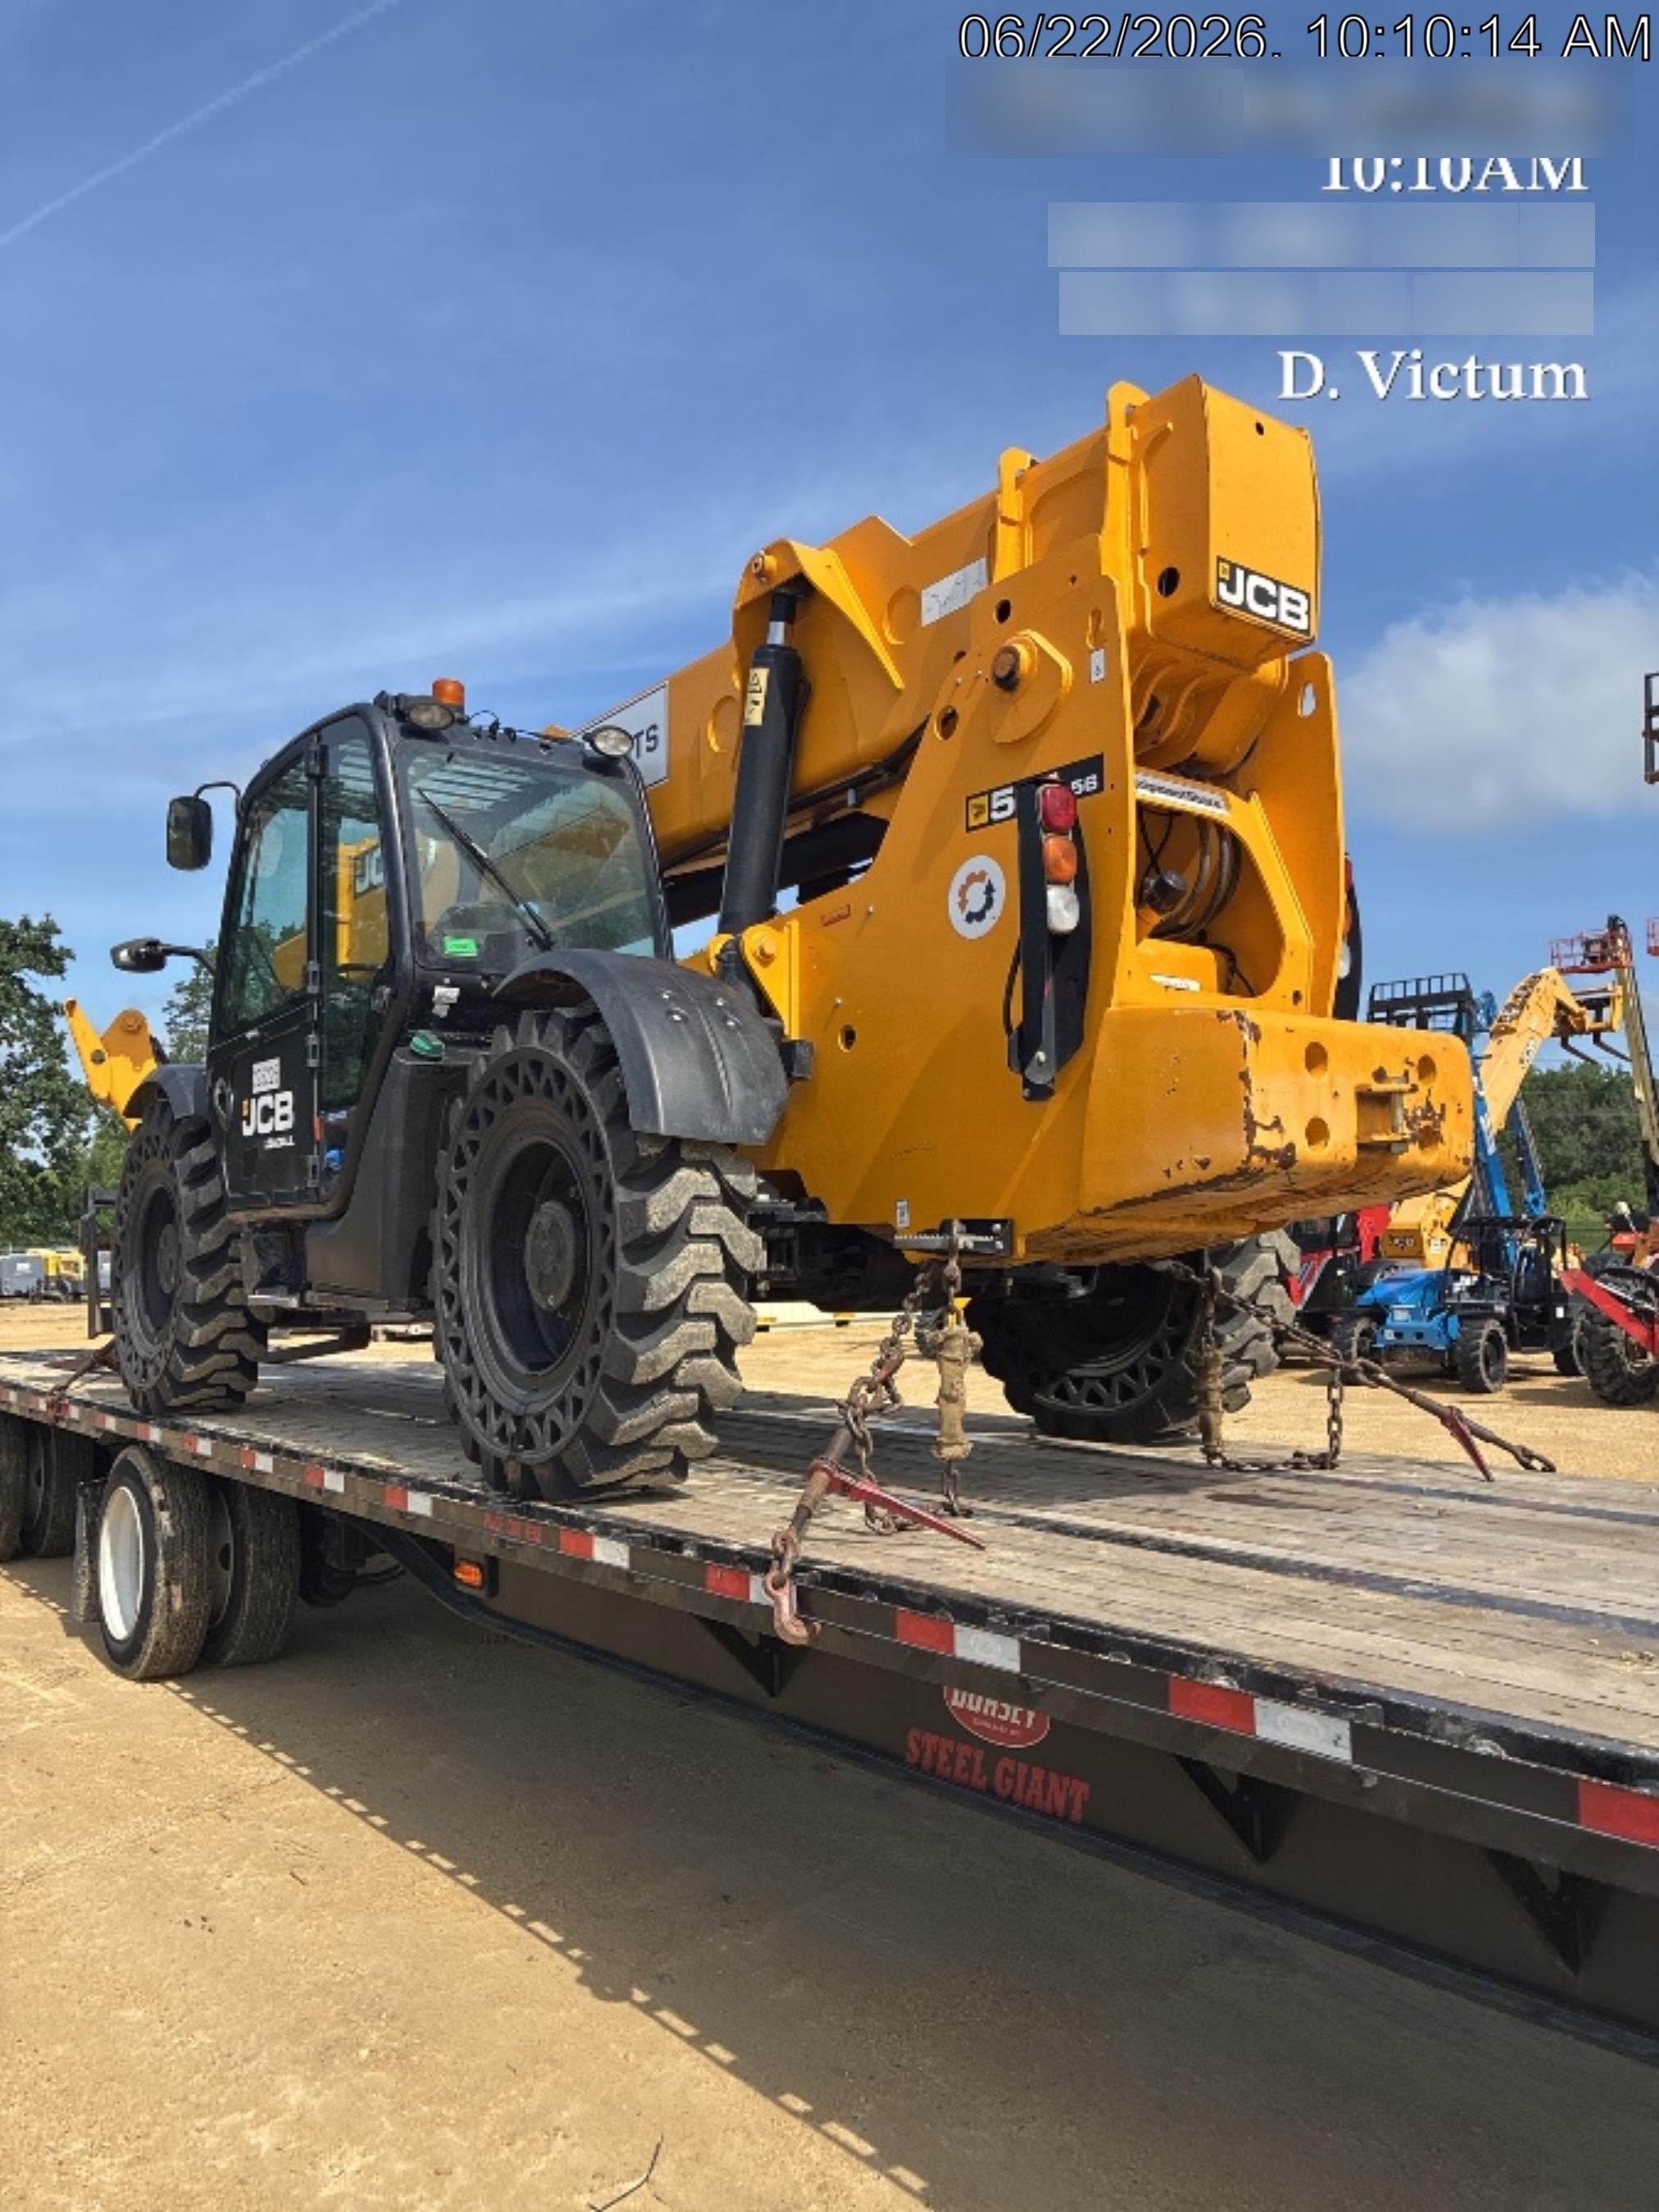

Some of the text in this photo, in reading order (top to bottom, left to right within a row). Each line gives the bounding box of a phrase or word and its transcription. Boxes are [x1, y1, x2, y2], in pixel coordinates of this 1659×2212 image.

[1218, 567, 1309, 631] JCB
[632, 723, 659, 759] TS
[356, 847, 384, 893] JC
[243, 1090, 294, 1136] JCB
[905, 1727, 1093, 1824] STEEL GIANT
